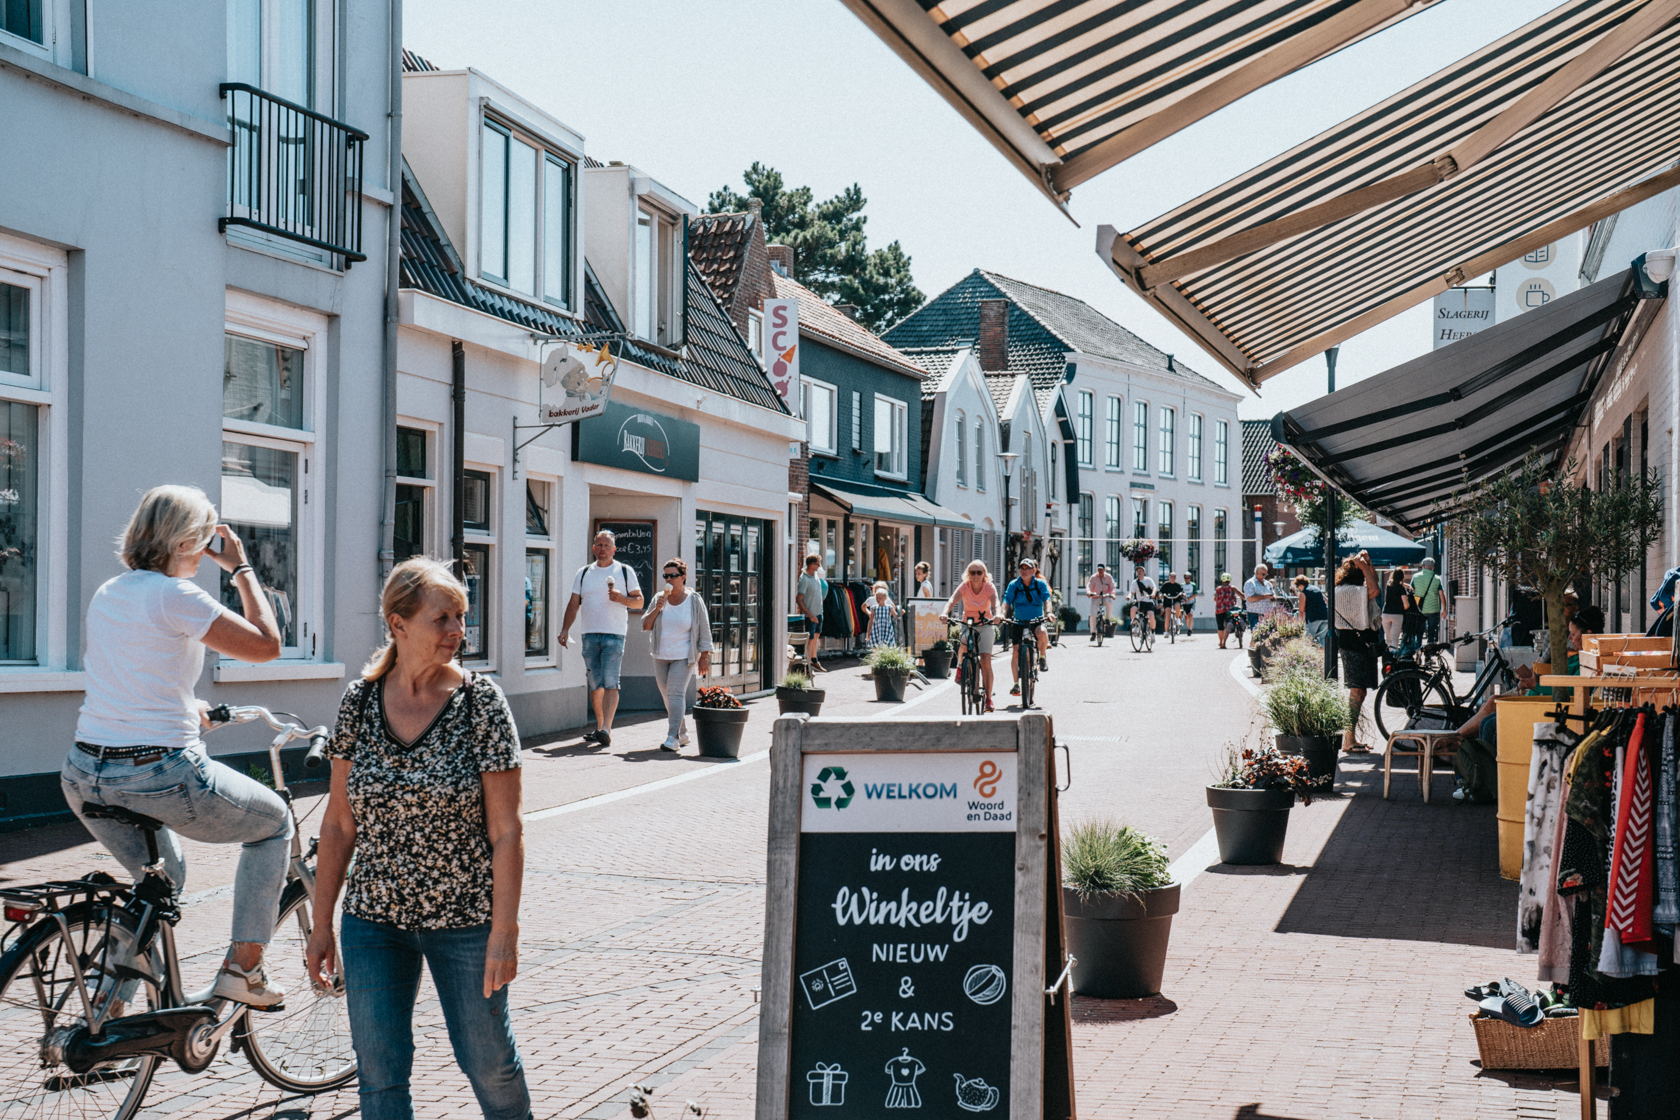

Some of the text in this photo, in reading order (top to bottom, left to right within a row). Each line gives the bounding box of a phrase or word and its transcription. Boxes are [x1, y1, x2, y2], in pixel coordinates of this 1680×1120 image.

[1437, 307, 1490, 321] SLAGERIJ
[1439, 328, 1477, 340] HEE
[926, 620, 946, 630] ARE
[917, 629, 947, 639] OPEN
[864, 782, 957, 799] WELKOM
[967, 800, 1004, 810] Woord
[966, 811, 1012, 821] en Daad
[870, 848, 942, 872] in ons
[831, 886, 993, 943] Winkeltje
[872, 943, 949, 963] NIEUW
[899, 976, 915, 998] &
[891, 1011, 954, 1032] KANS
